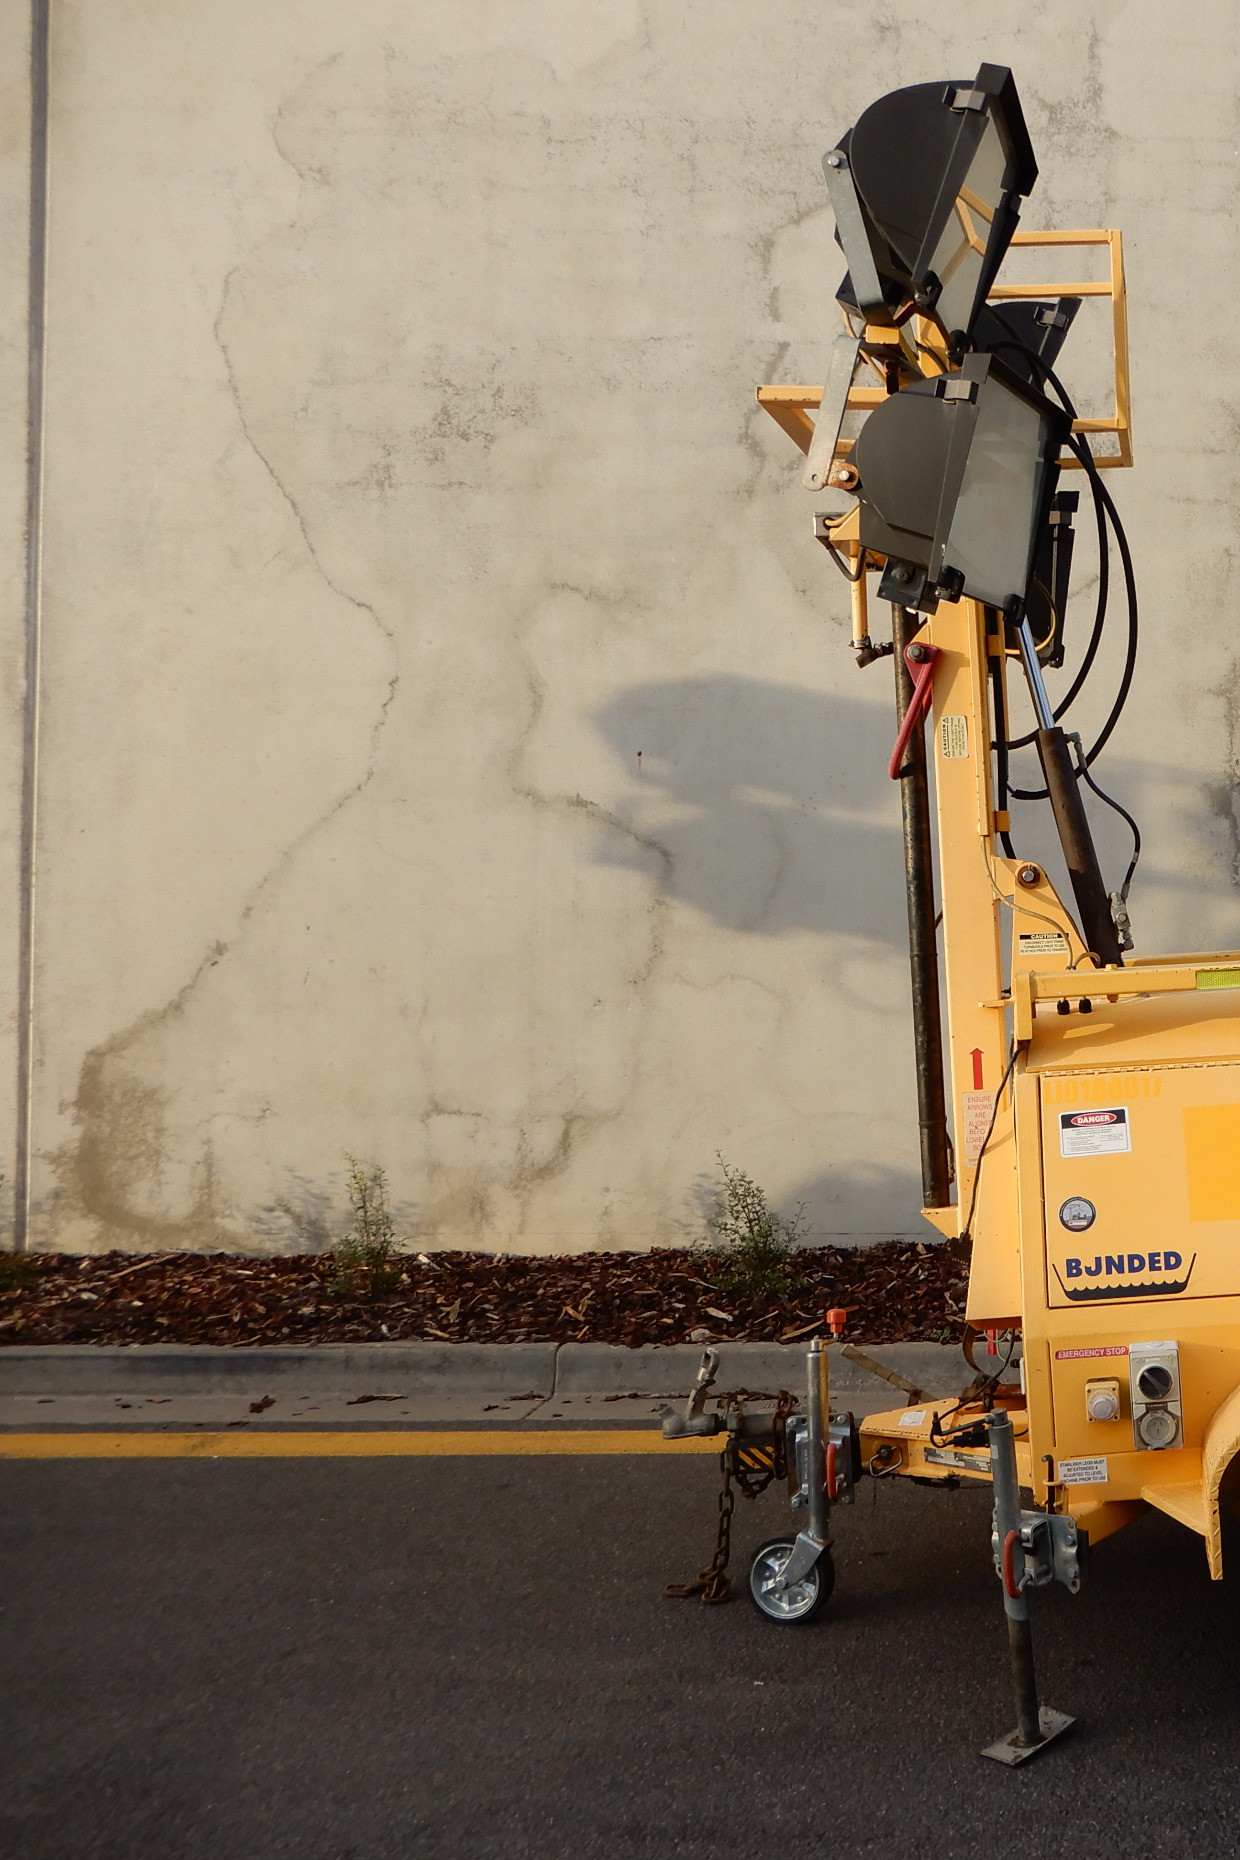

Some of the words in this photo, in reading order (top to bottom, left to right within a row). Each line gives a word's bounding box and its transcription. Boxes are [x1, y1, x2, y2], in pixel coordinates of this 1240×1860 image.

[1077, 1115, 1110, 1124] DANGER
[1058, 1349, 1105, 1359] EMERGENCY
[1106, 1347, 1126, 1356] STOP
